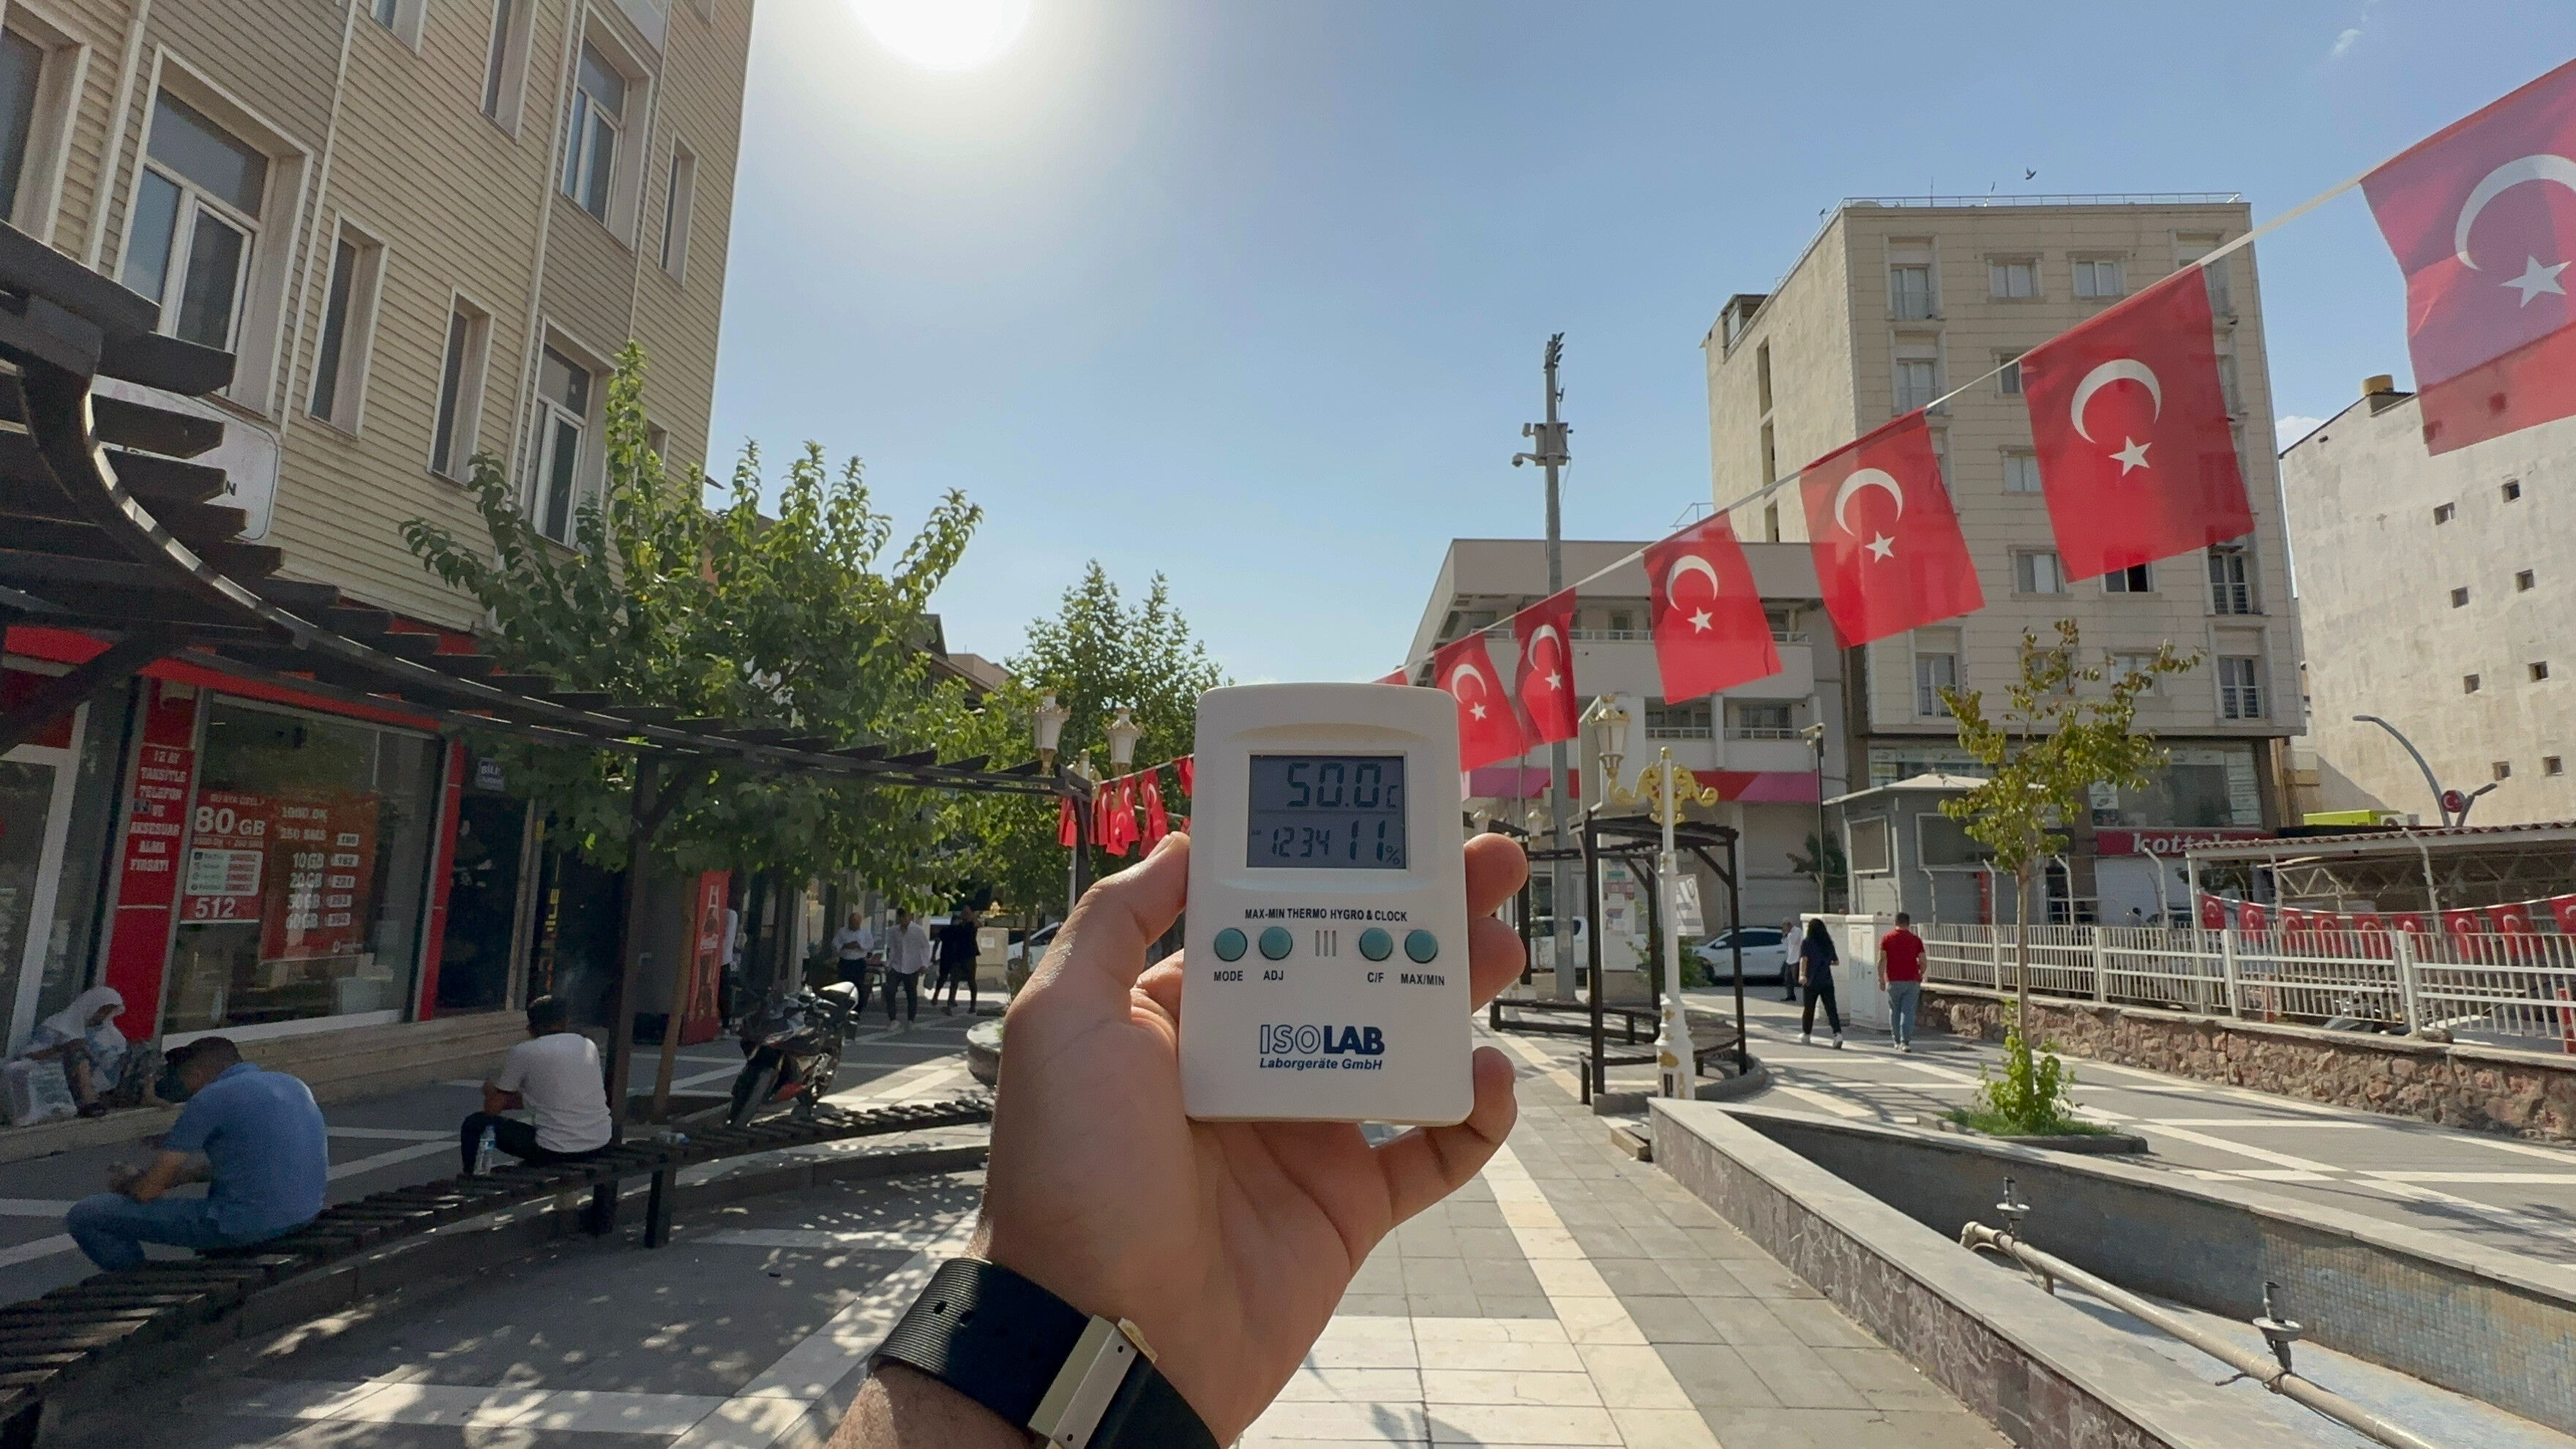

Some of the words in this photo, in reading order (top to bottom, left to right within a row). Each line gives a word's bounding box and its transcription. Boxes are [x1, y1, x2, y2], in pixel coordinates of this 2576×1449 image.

[139, 785, 183, 800] TELEFON
[194, 806, 236, 835] 80
[239, 818, 266, 836] GB
[293, 852, 307, 869] 10
[290, 872, 304, 888] 20
[306, 872, 322, 888] GB
[195, 896, 236, 918] 512
[1245, 908, 1285, 919] MAX-MIN
[1288, 908, 1327, 919] THERMO
[1330, 910, 1364, 921] HYGRO
[1366, 910, 1373, 921] &
[1374, 910, 1407, 922] CLOCK
[1213, 970, 1243, 981] MODE
[1263, 970, 1284, 981] ADJ
[1367, 972, 1385, 984] C/F
[1400, 973, 1445, 986] MAX/MIN
[1259, 1024, 1385, 1055] ISOLAB
[1259, 1057, 1338, 1071] Laborgeräte
[1341, 1058, 1382, 1070] GmbH
